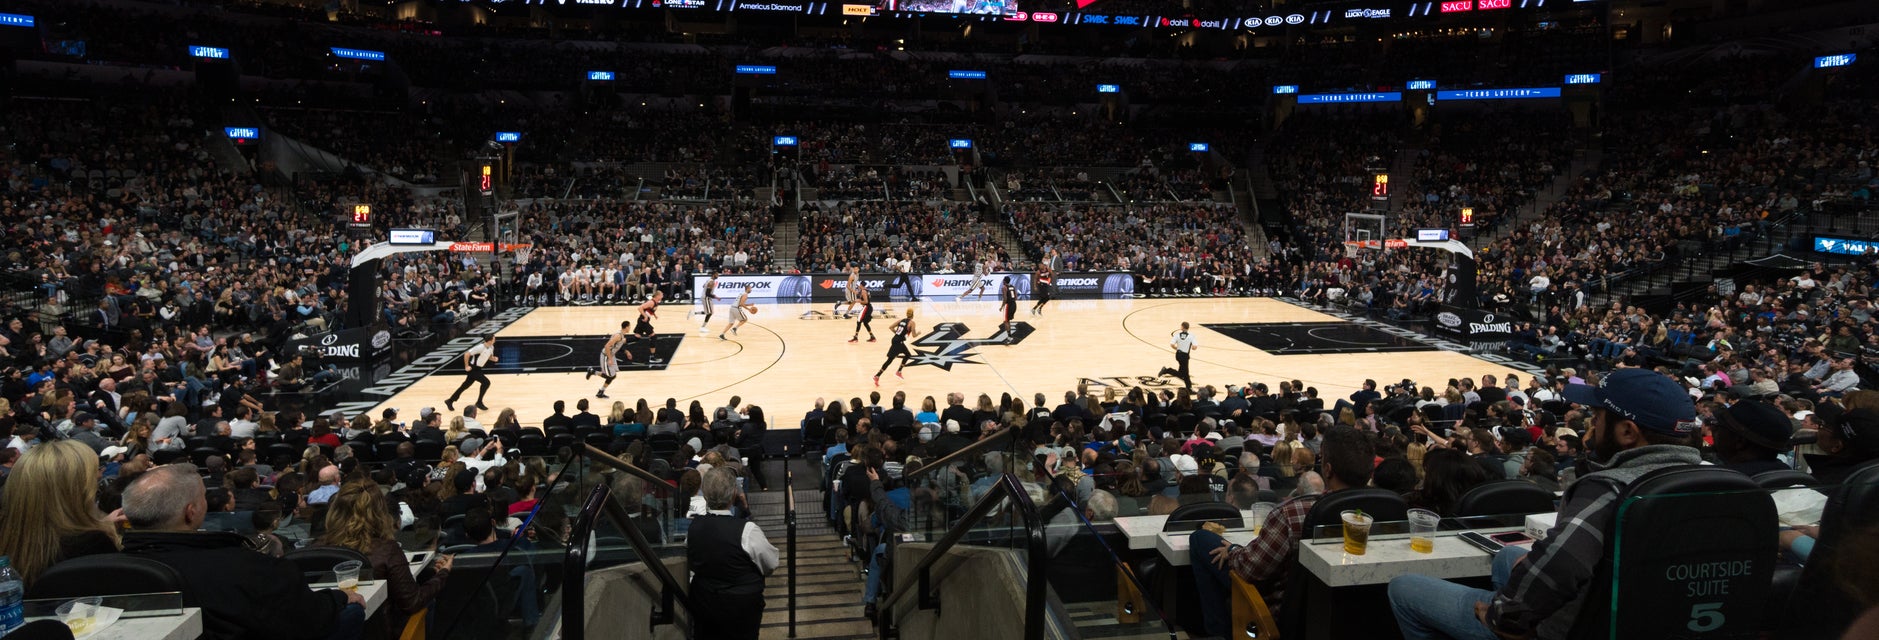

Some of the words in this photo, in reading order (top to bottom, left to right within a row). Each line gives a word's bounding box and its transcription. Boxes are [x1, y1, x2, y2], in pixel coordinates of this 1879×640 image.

[1442, 2, 1471, 12] SACU
[1083, 15, 1108, 23] SWBC
[1114, 16, 1139, 25] SWBC
[1169, 19, 1189, 27] dahill
[1200, 20, 1220, 28] dahill
[1494, 89, 1531, 97] LOTTERY
[1374, 182, 1387, 195] 21
[354, 212, 367, 222] 21
[1469, 321, 1512, 335] SPALDING
[1666, 560, 1752, 581] COURTSIDE
[1687, 579, 1729, 598] SUITE
[1686, 601, 1726, 633] 5
